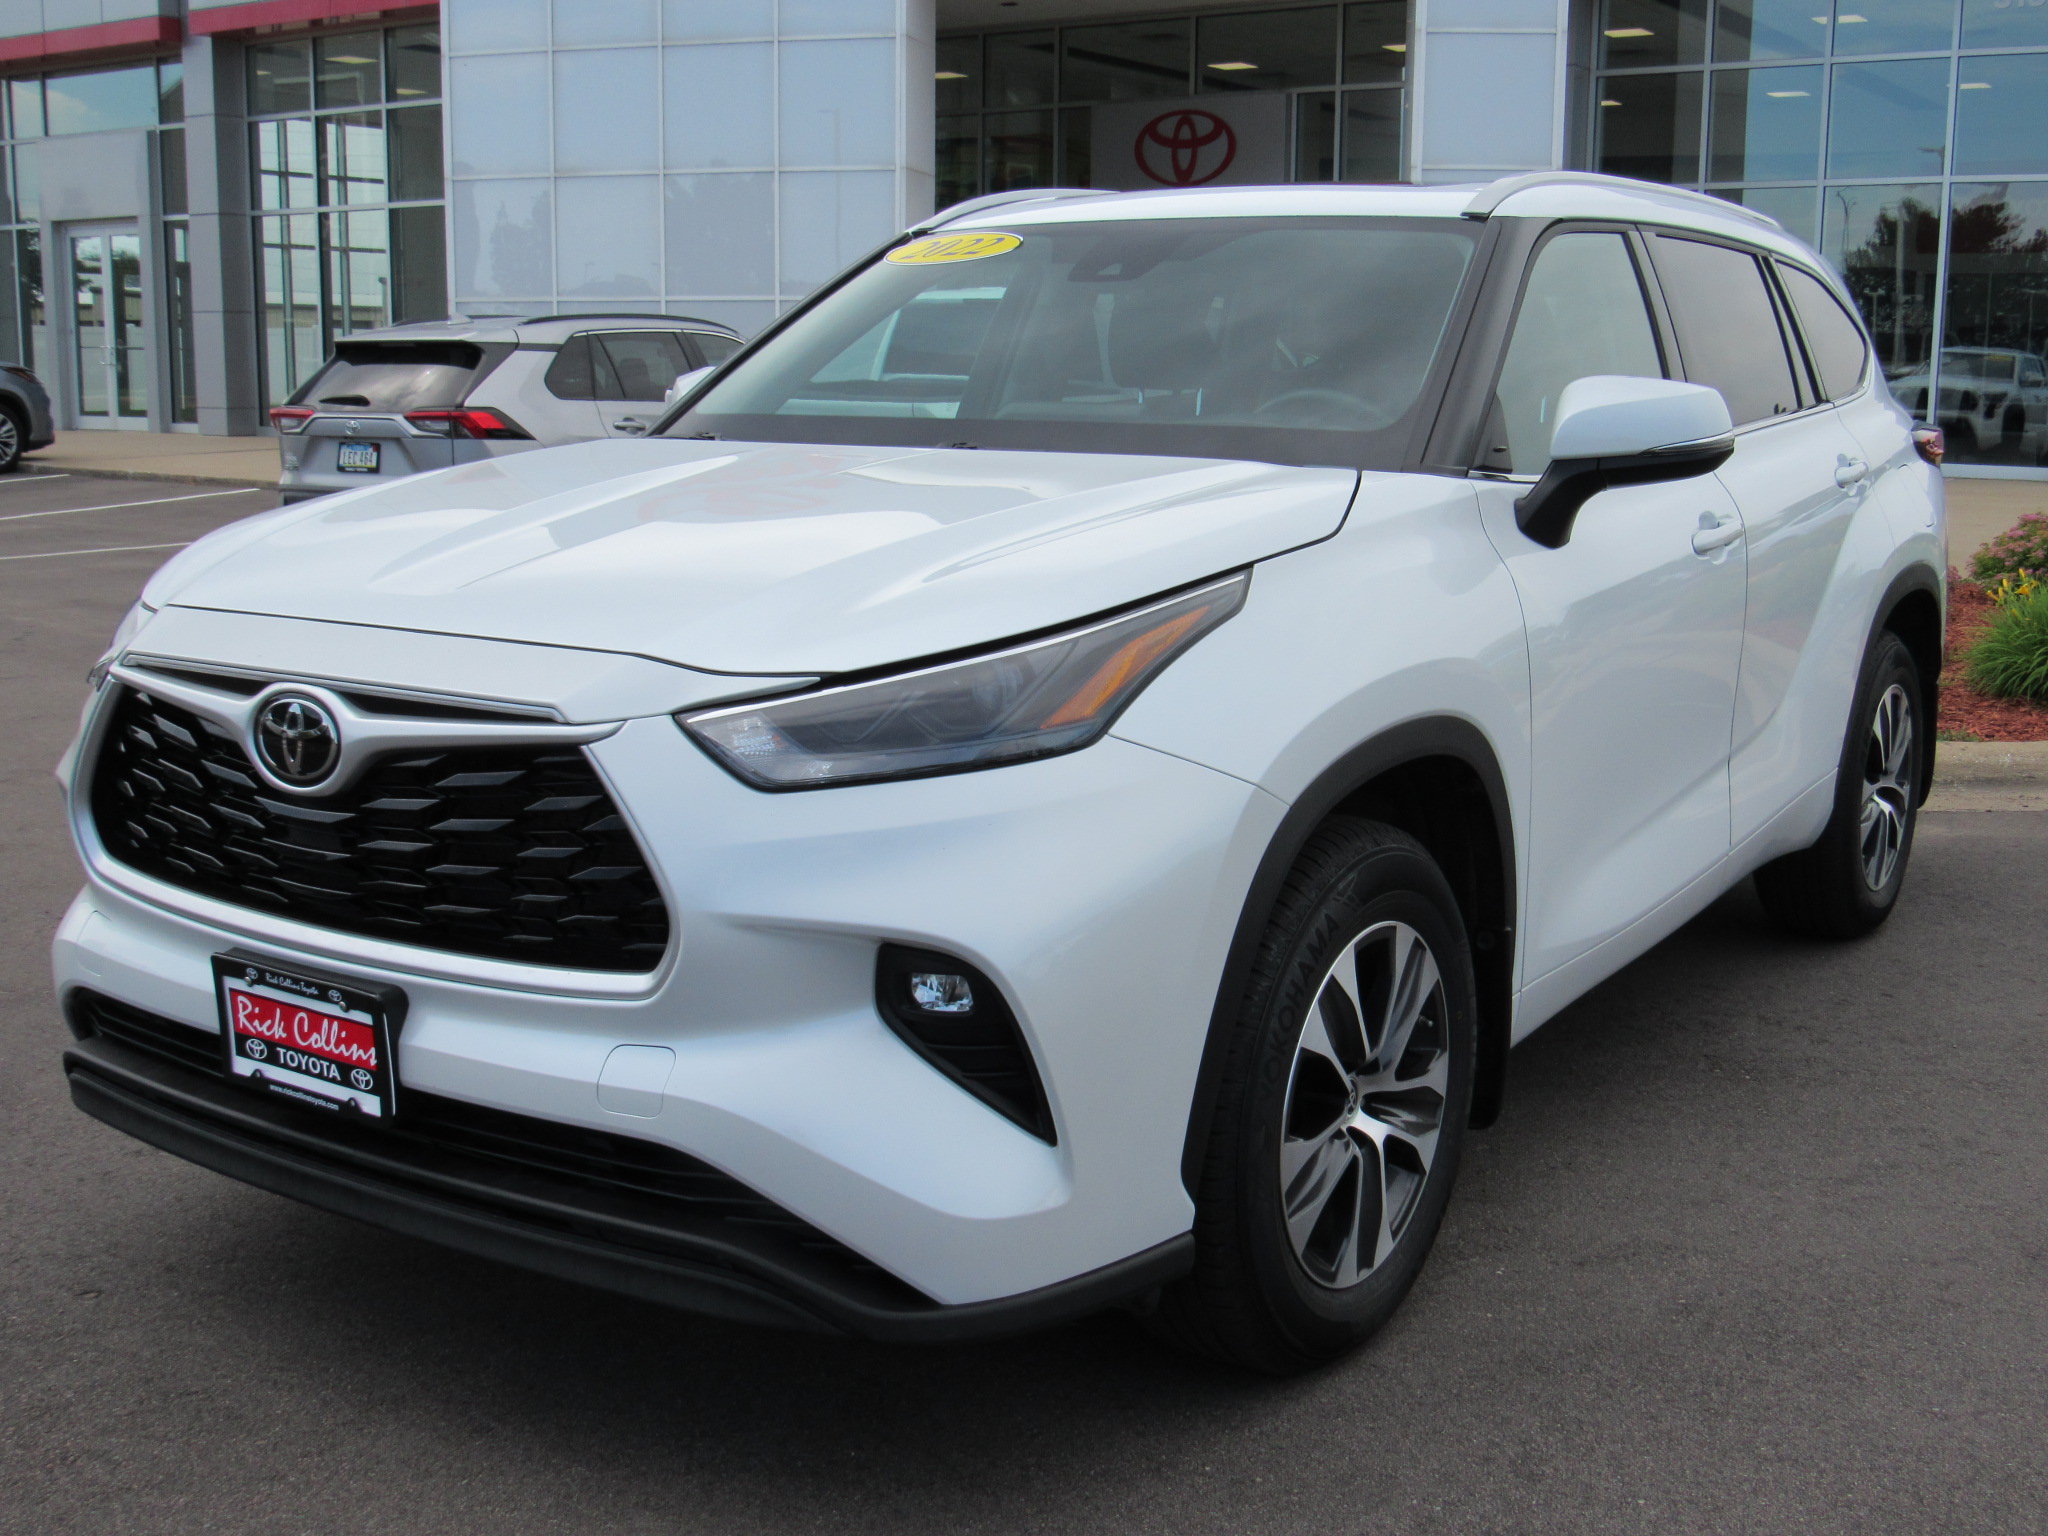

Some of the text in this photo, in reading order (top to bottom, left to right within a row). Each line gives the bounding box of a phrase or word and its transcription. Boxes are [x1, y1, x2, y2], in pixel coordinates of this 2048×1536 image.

[899, 237, 1006, 260] 2022
[265, 972, 319, 995] Rick Collins Toyota
[1259, 912, 1340, 1101] YOKOHAMA
[237, 995, 378, 1066] Rick Collins
[276, 1047, 341, 1081] TOYOTA
